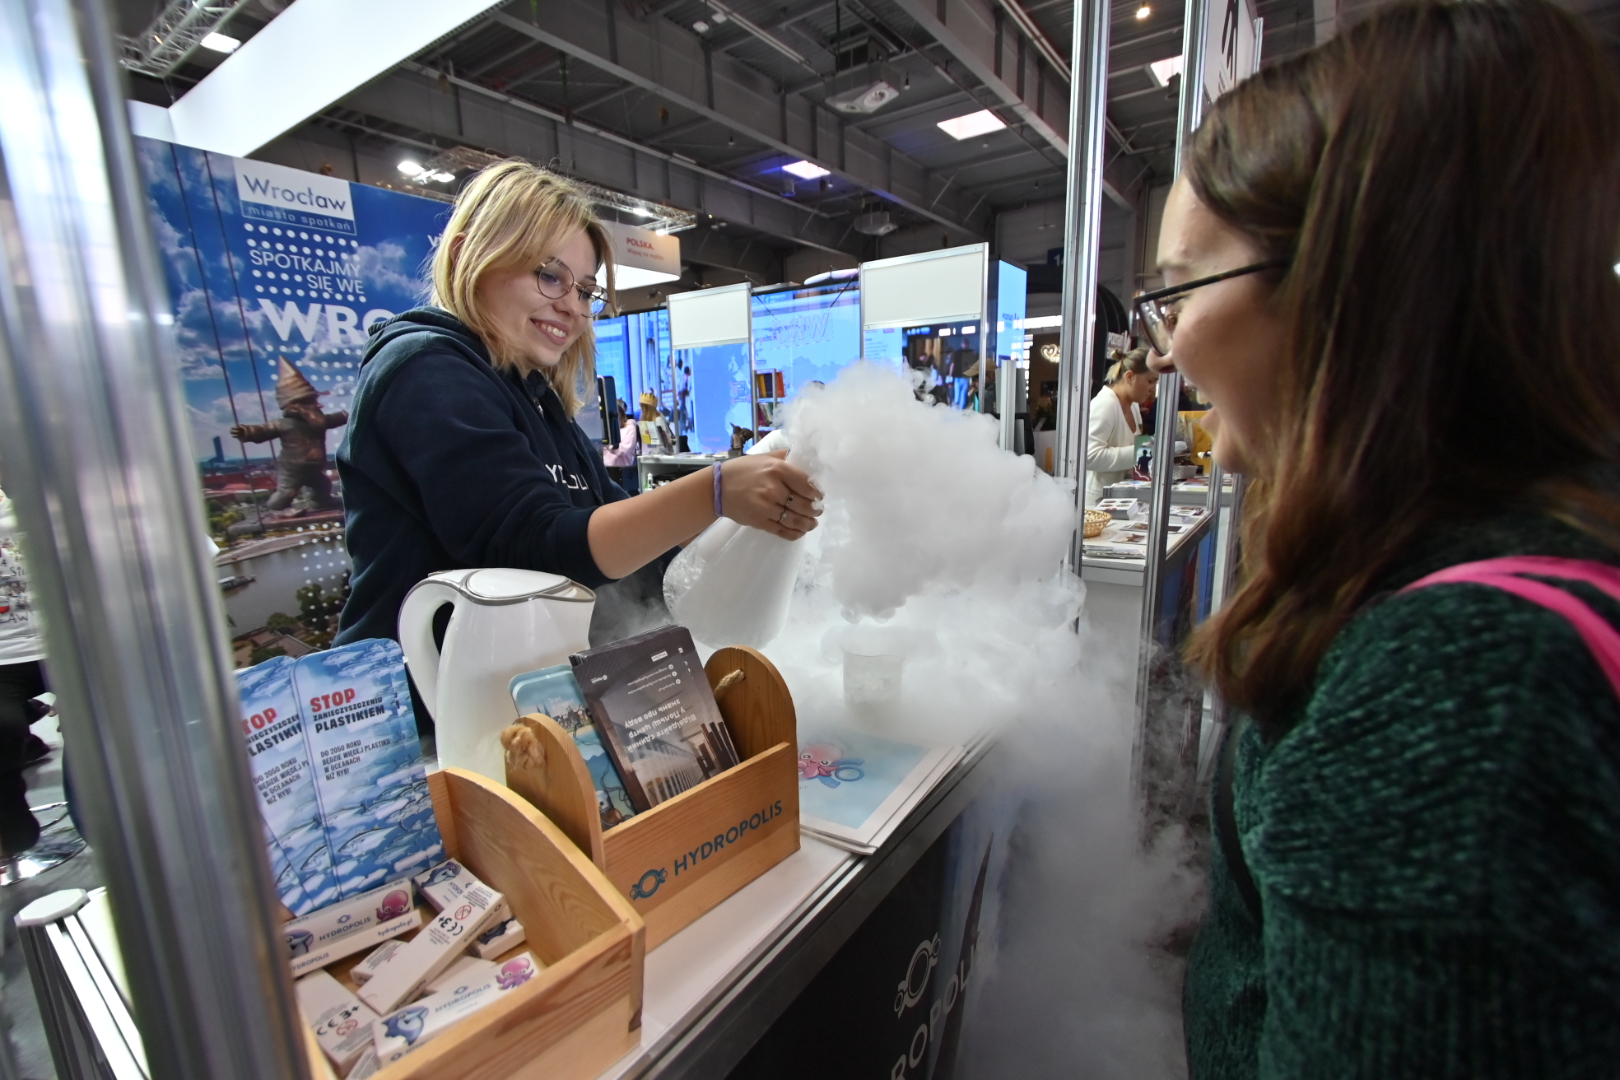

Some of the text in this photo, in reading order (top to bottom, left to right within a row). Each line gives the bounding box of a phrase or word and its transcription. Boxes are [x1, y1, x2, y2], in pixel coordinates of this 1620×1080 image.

[243, 173, 347, 213] Wrocław
[247, 203, 351, 232] miasto spotkań
[250, 249, 360, 278] SPOTKAJMY
[307, 274, 364, 295] SIĘ WE
[310, 688, 356, 713] STOP
[313, 697, 383, 721] ZANIECZYSZCZENIU
[241, 707, 277, 735] TOP
[315, 705, 386, 733] PLASTIKIEM
[624, 699, 681, 729] знань про воду
[652, 708, 682, 729] Польщі
[659, 713, 698, 740] Відвідайте
[628, 722, 652, 739] центр
[321, 739, 362, 757] DO 2050 ROKU
[322, 738, 391, 767] BĘDZIE WIĘCEJ PLASTIKU
[264, 764, 278, 778] 2050
[279, 757, 297, 771] ROKU
[324, 756, 361, 774] W OCEANACH
[270, 773, 301, 795] OCEANACH
[674, 800, 783, 876] HYDROPOLIS
[319, 916, 372, 941] HYDROPOLIS
[291, 952, 330, 972] YDROPOLIS
[434, 983, 492, 1014] HYDROPOLIS
